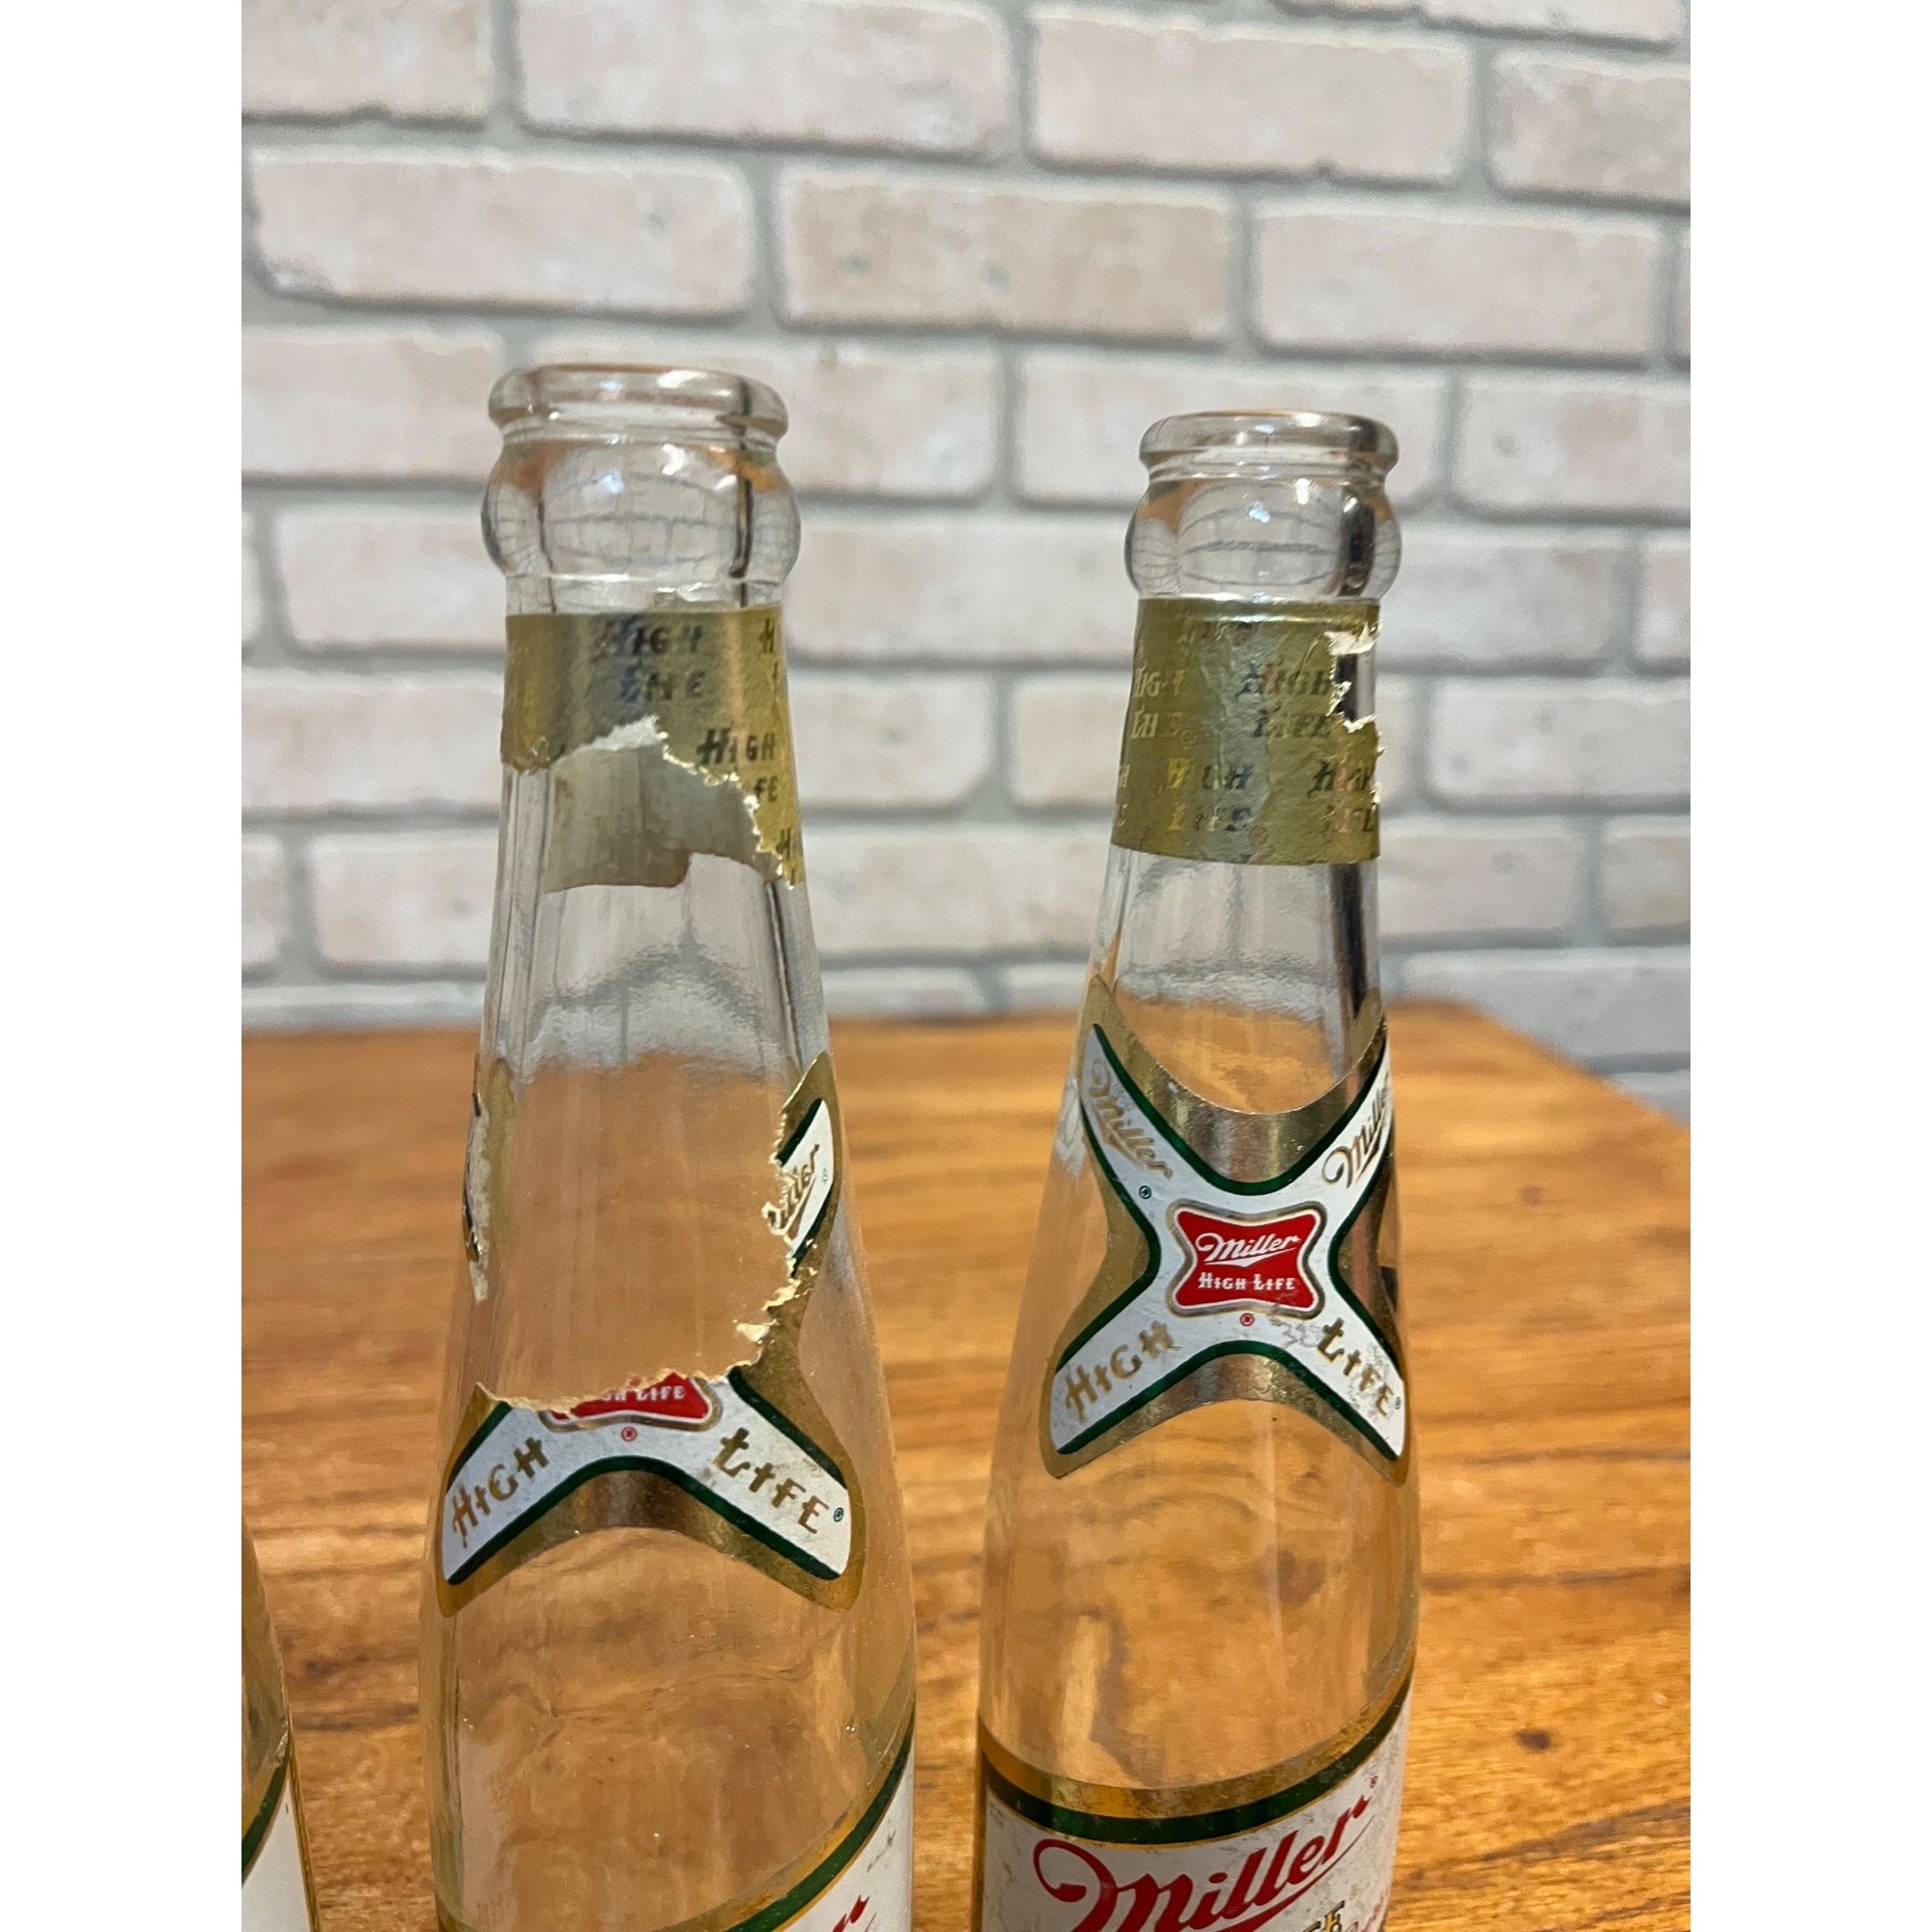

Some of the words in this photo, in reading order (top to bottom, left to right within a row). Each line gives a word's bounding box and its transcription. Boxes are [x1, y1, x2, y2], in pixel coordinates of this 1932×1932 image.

[696, 723, 777, 765] HIGH
[1092, 1058, 1174, 1179] Miller
[1195, 1232, 1301, 1266] Miller
[1198, 1271, 1246, 1290] HIGH
[1253, 1273, 1295, 1291] LIFE
[1065, 1320, 1175, 1422] HIGH
[1316, 1317, 1394, 1417] LIFE
[452, 1435, 549, 1548] HIGH
[714, 1427, 829, 1535] LIFE
[1033, 1795, 1371, 1932] Miller
